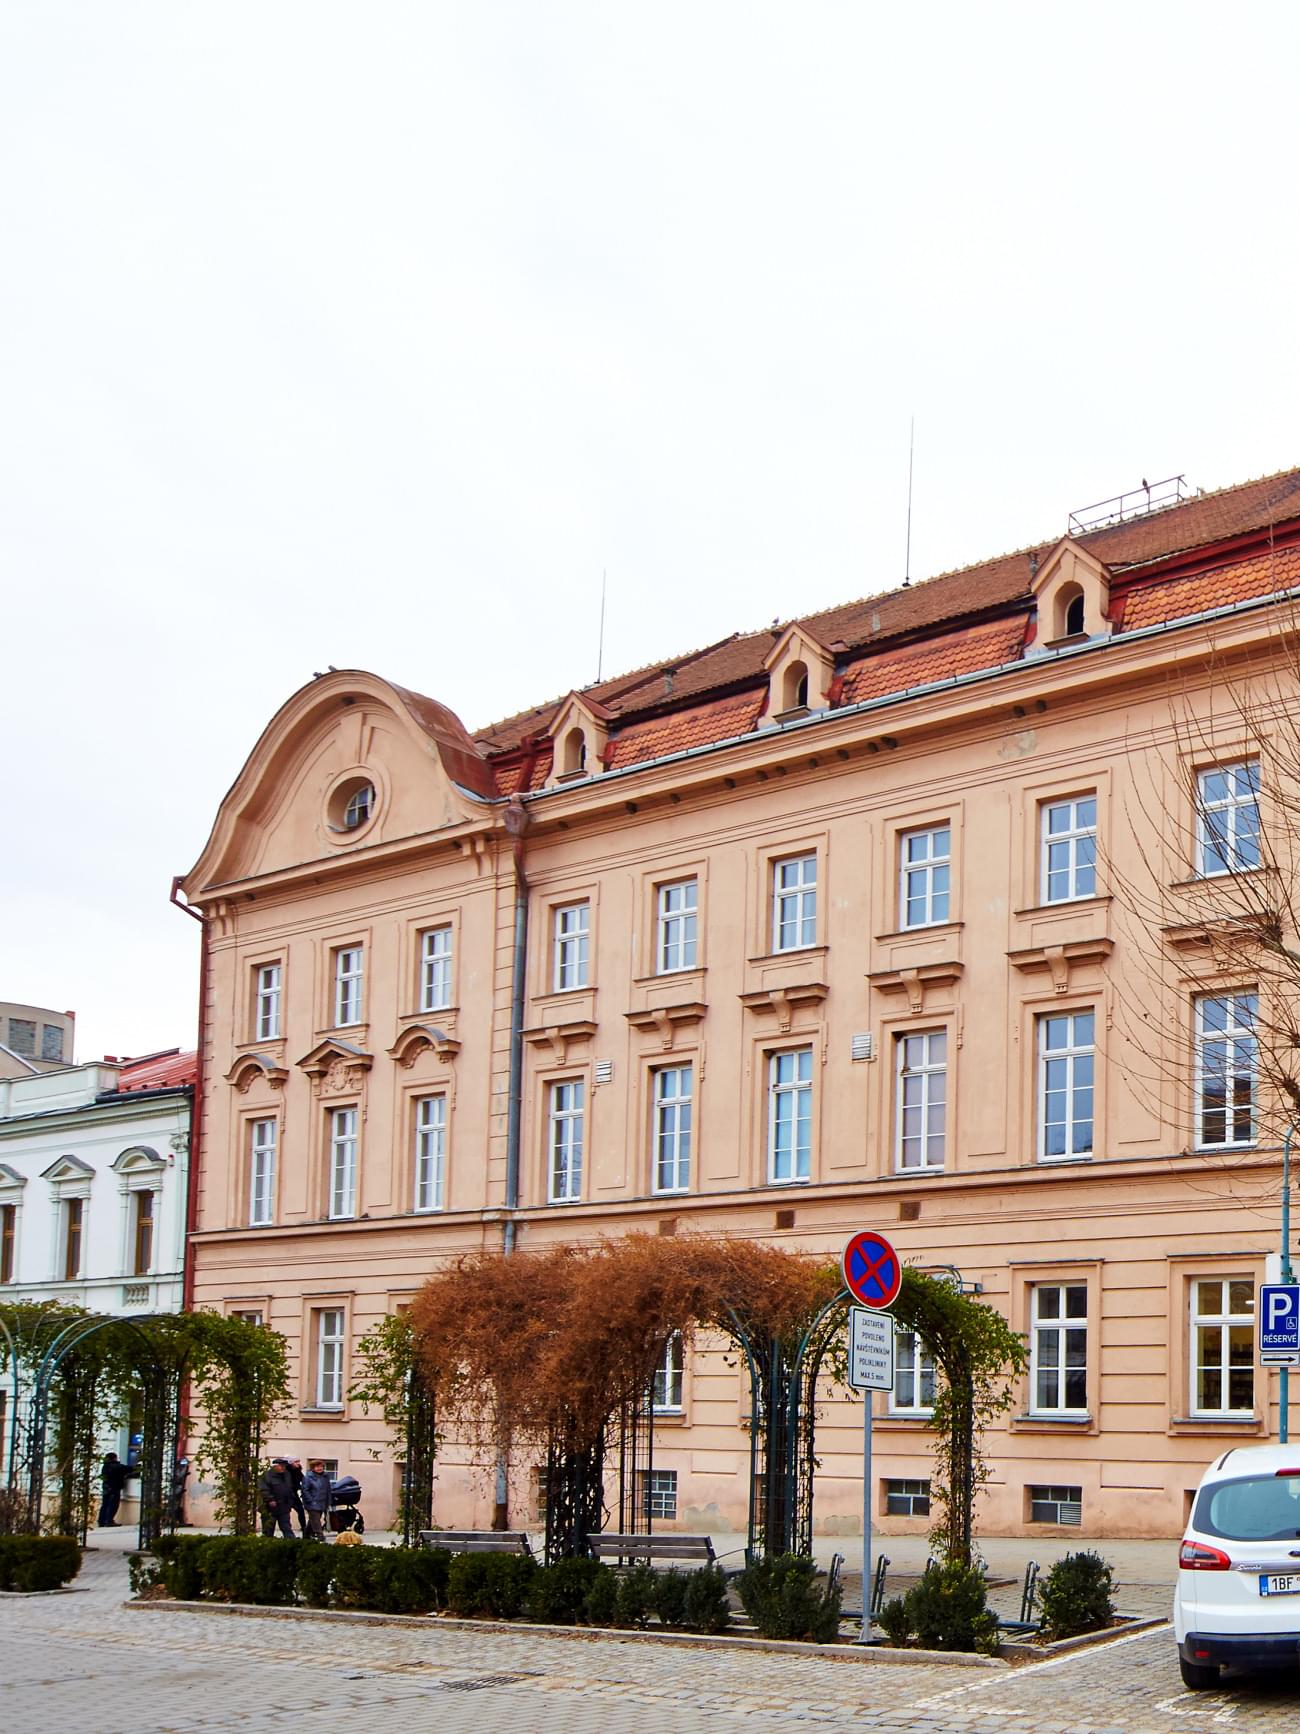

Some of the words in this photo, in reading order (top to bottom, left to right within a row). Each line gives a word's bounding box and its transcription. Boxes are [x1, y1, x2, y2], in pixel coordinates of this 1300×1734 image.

[1268, 1293, 1292, 1330] P
[1263, 1332, 1297, 1343] RÉSERVÉ
[1271, 1576, 1294, 1590] 1BF
